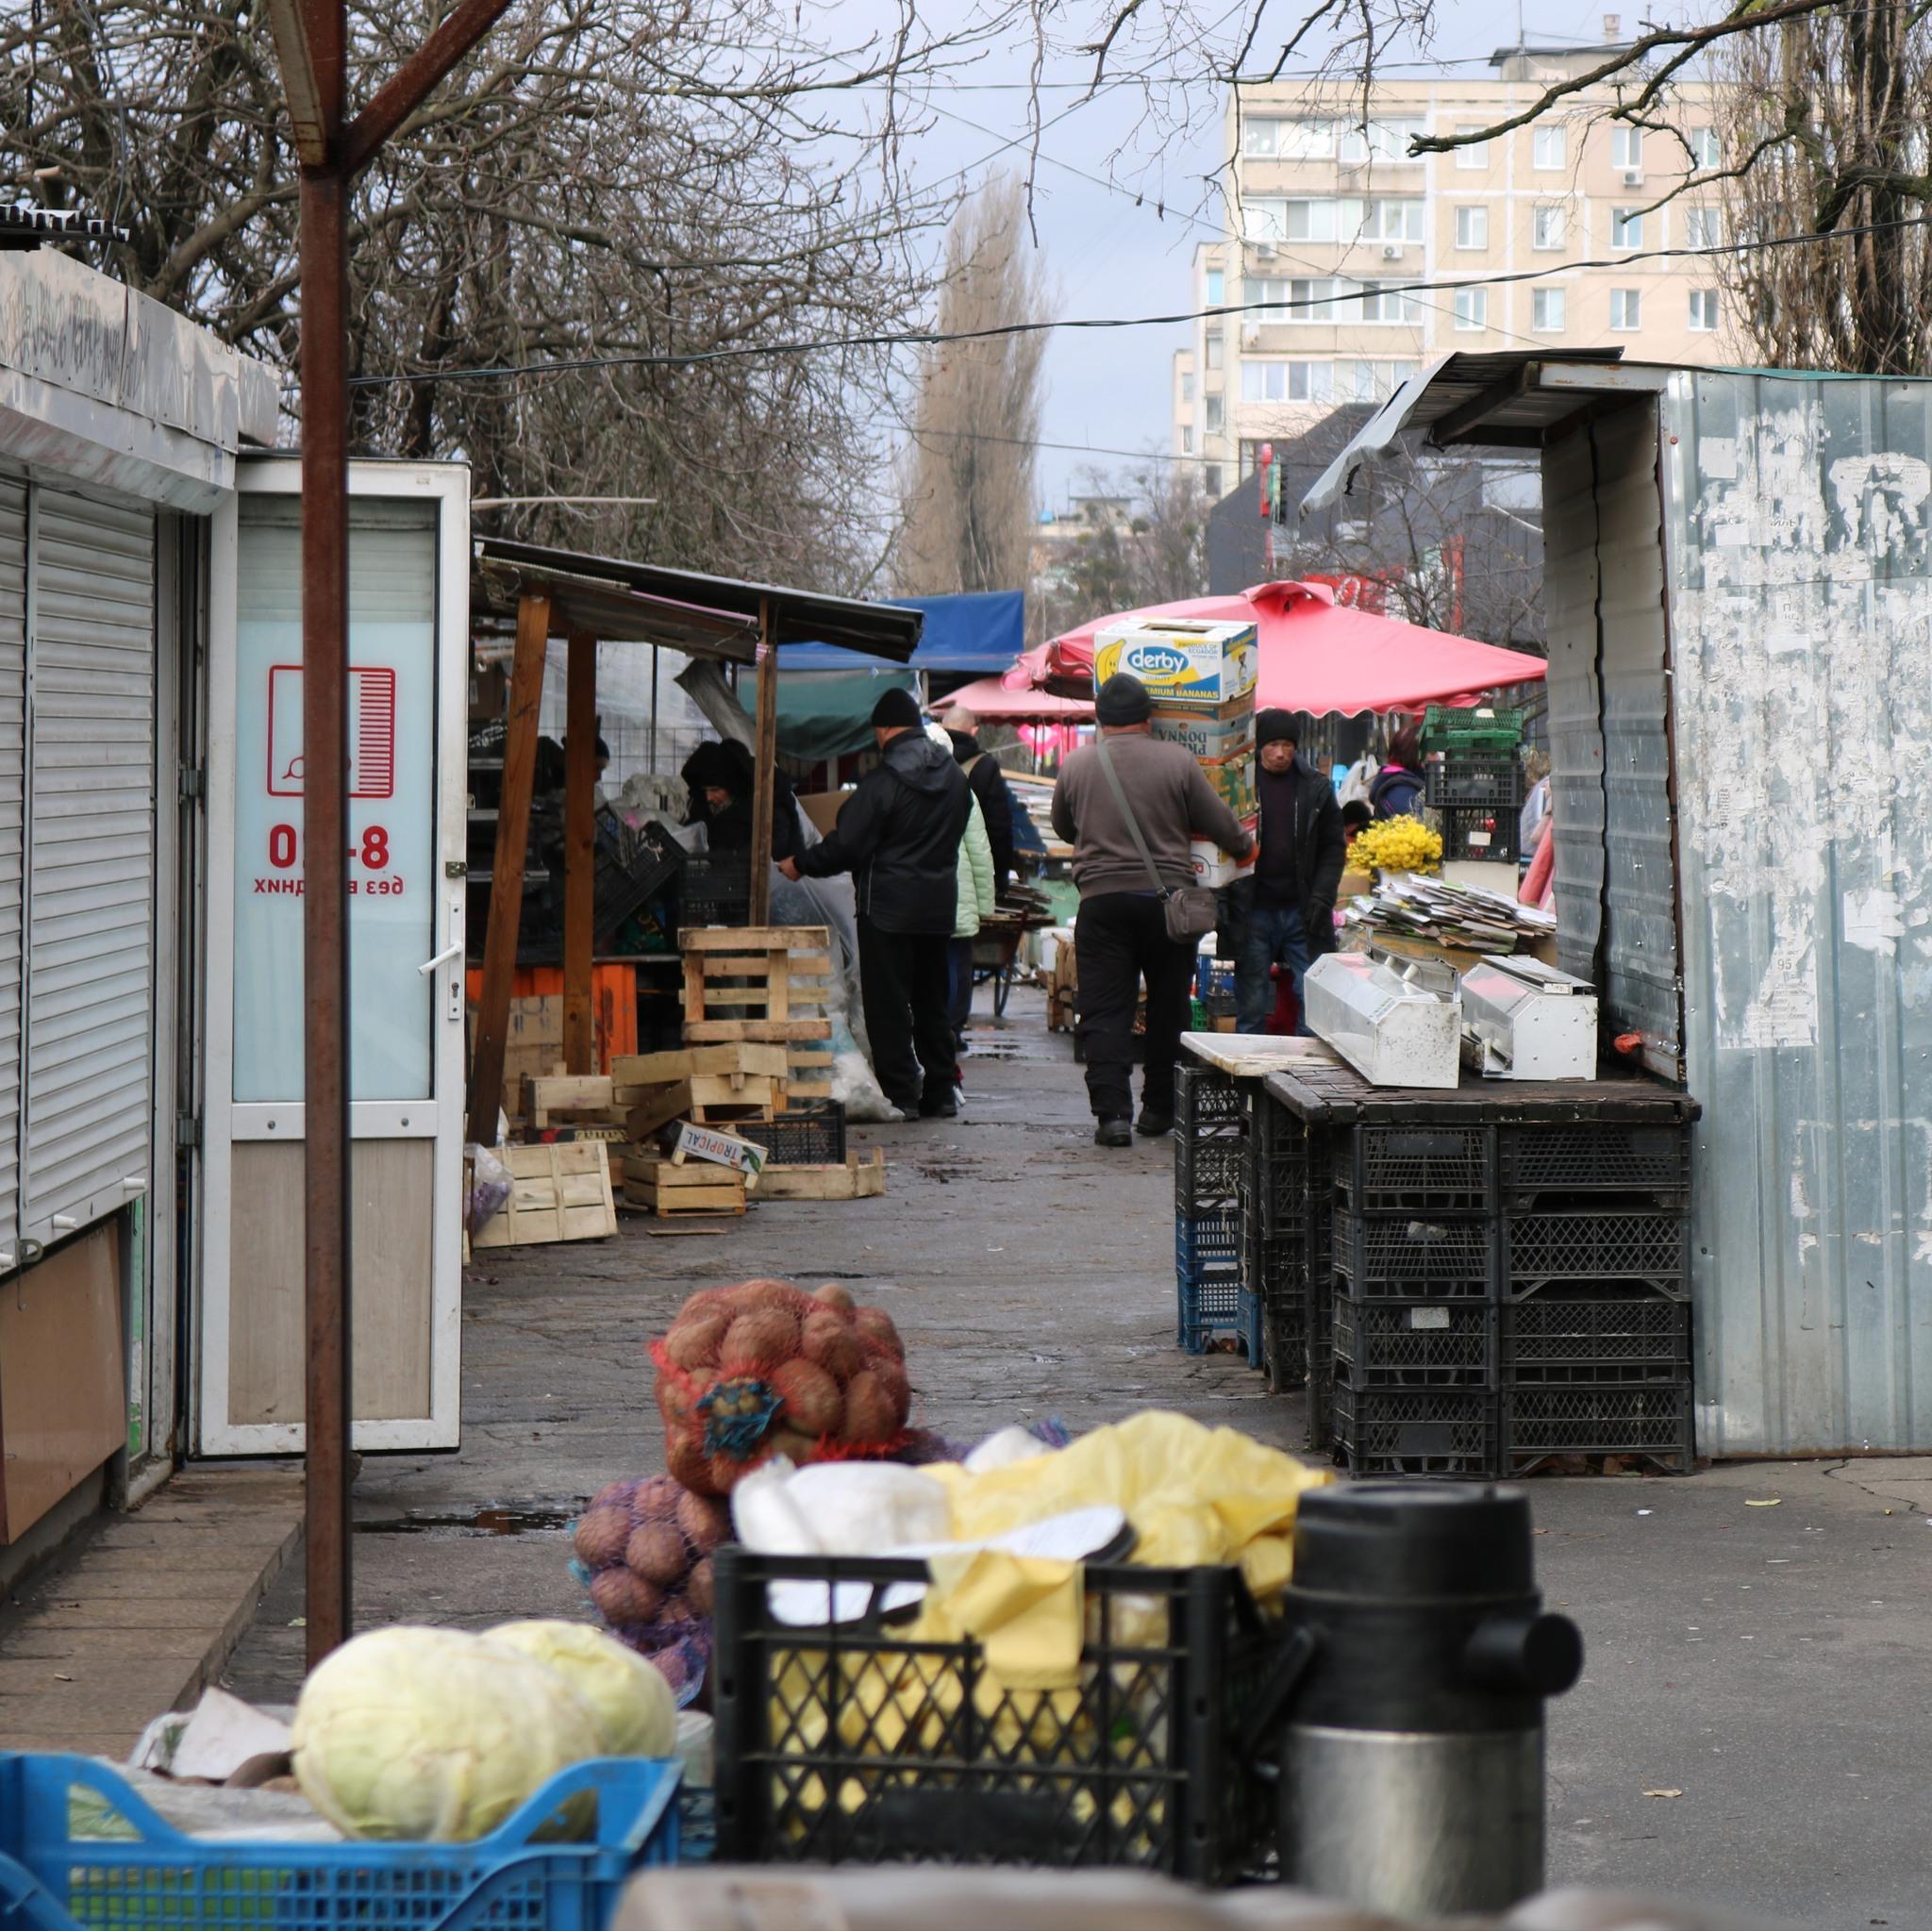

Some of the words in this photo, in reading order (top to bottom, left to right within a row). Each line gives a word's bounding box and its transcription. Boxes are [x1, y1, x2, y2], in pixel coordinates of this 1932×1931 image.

[1132, 647, 1185, 674] derby
[1176, 689, 1219, 699] BANANAS
[1158, 729, 1208, 743] DONNA
[687, 1131, 738, 1160] TROPICAL
